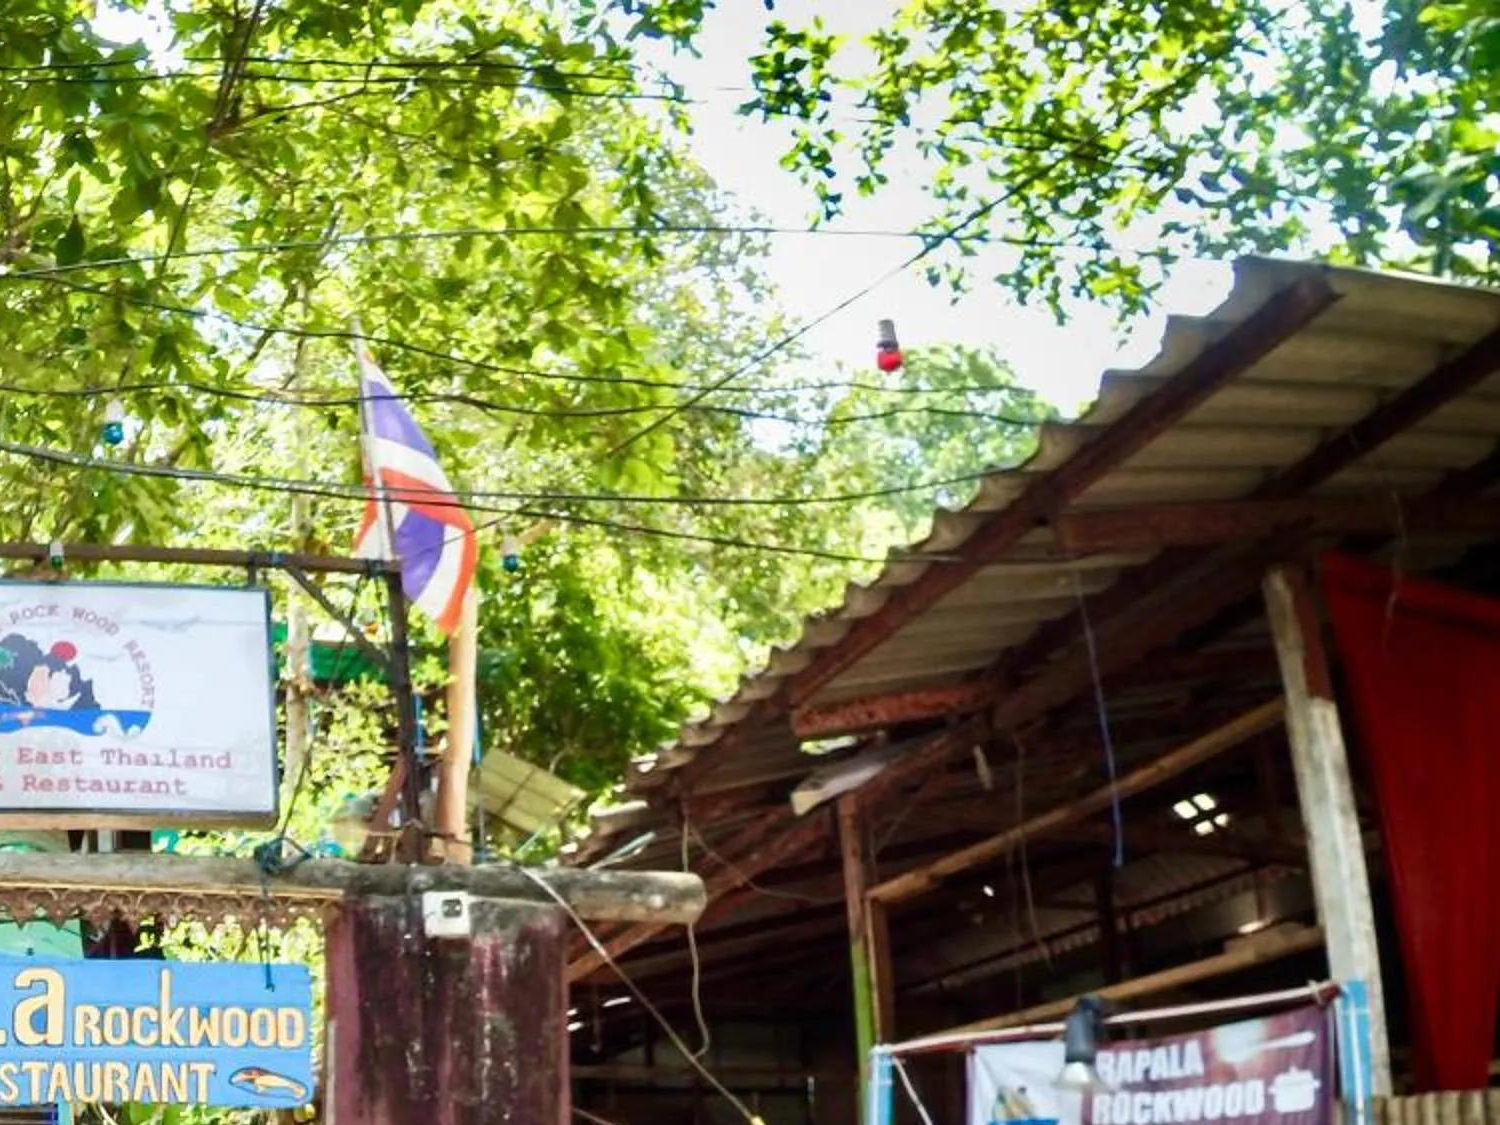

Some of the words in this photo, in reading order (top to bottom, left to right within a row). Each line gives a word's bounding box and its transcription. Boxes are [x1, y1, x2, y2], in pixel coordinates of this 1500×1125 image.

[9, 604, 60, 625] ROCK
[72, 606, 121, 637] WOOD
[122, 639, 155, 709] RESORT
[16, 747, 84, 767] East
[100, 747, 233, 769] Thailand
[21, 776, 188, 797] Restaurant
[1095, 1039, 1205, 1085] RAPALA
